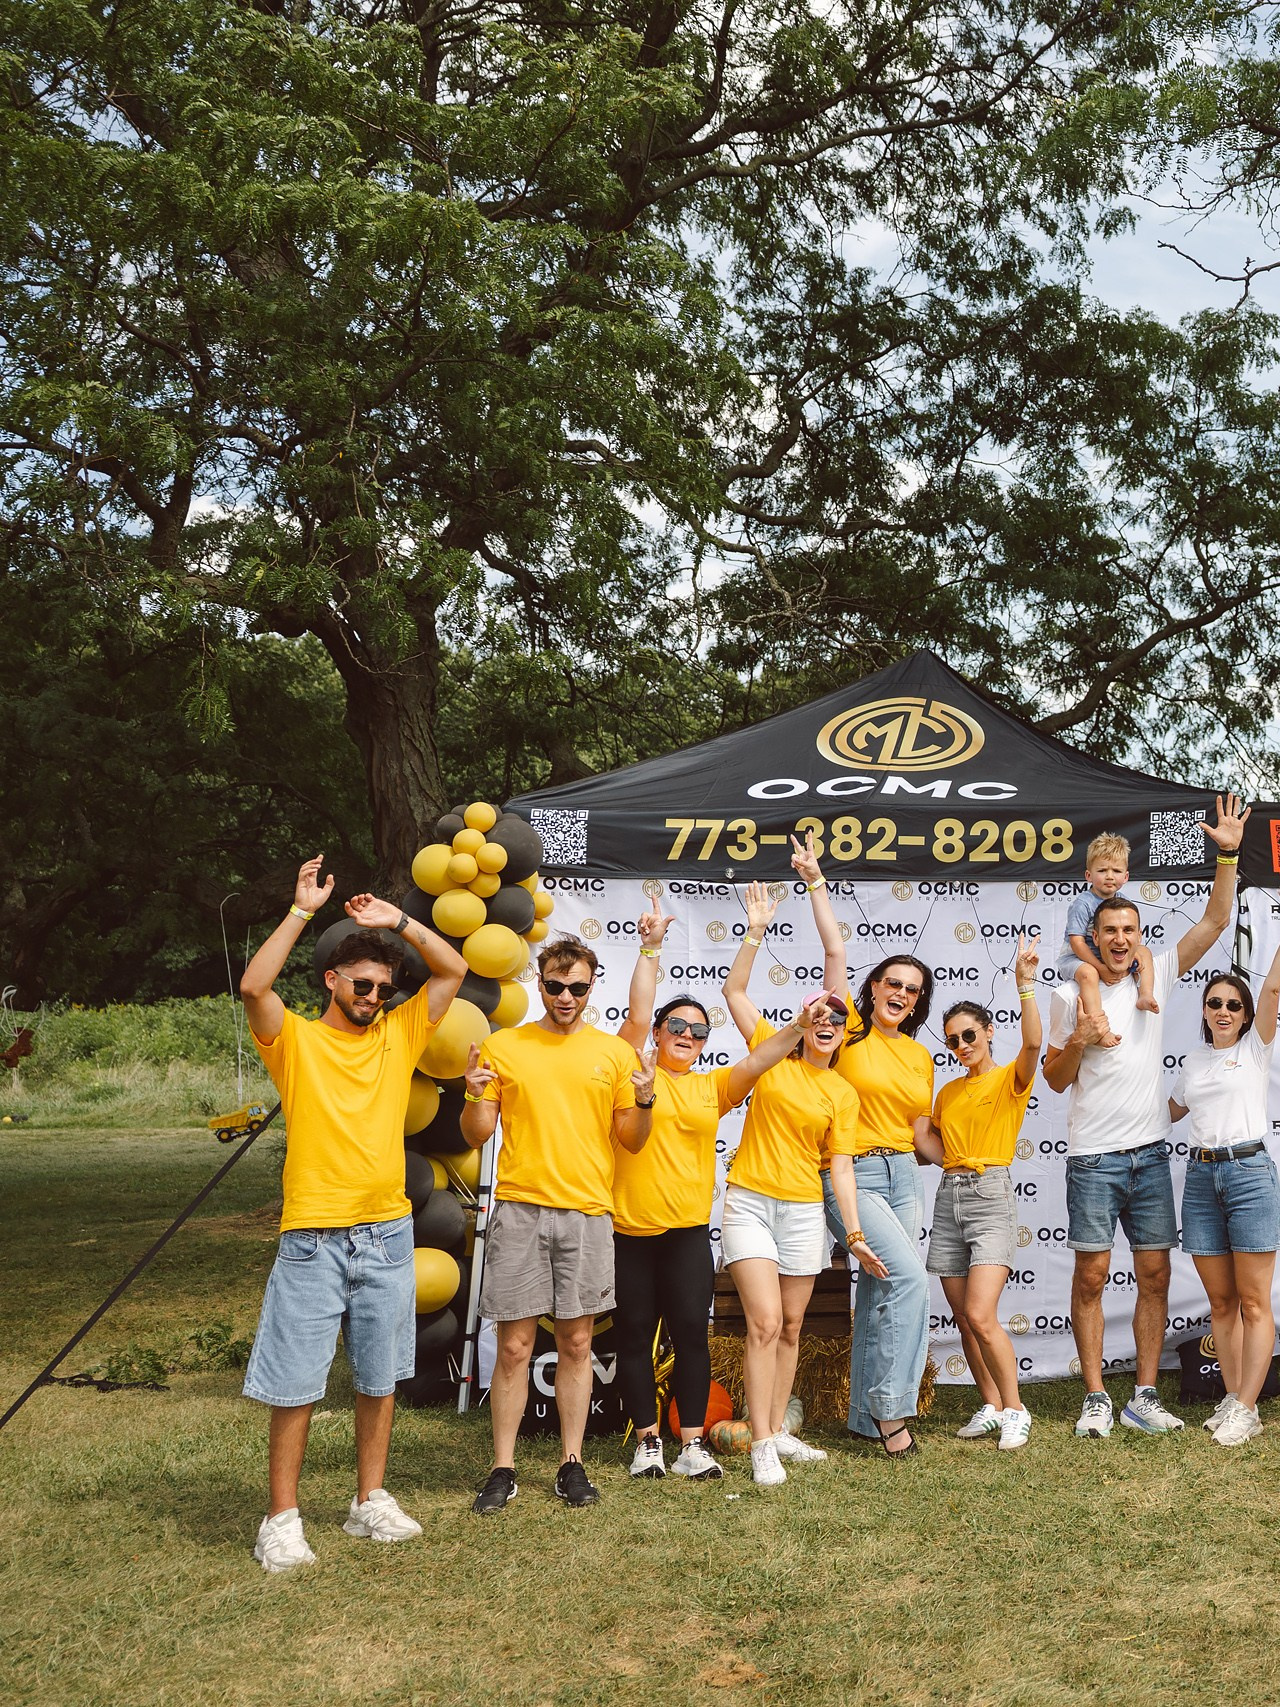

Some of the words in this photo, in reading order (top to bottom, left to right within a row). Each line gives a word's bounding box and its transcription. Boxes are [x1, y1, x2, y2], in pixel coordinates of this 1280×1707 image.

[747, 776, 1018, 800] OCMC
[665, 815, 1074, 863] 773-382-8208
[543, 877, 604, 891] OCMC
[669, 882, 729, 895] OCMC
[794, 882, 854, 895] OMC
[918, 882, 979, 895] OCMC
[1043, 883, 1092, 895] OCM
[1167, 883, 1211, 896] OCM
[732, 923, 793, 935] OMC
[857, 923, 917, 936] OCMC
[981, 924, 1041, 937] OCMC
[671, 966, 730, 979] OCMC
[934, 967, 979, 980] CMC
[763, 1008, 793, 1021] MC
[1039, 1141, 1068, 1153] OC
[1038, 1228, 1066, 1241] OC
[1006, 1270, 1035, 1283] MC
